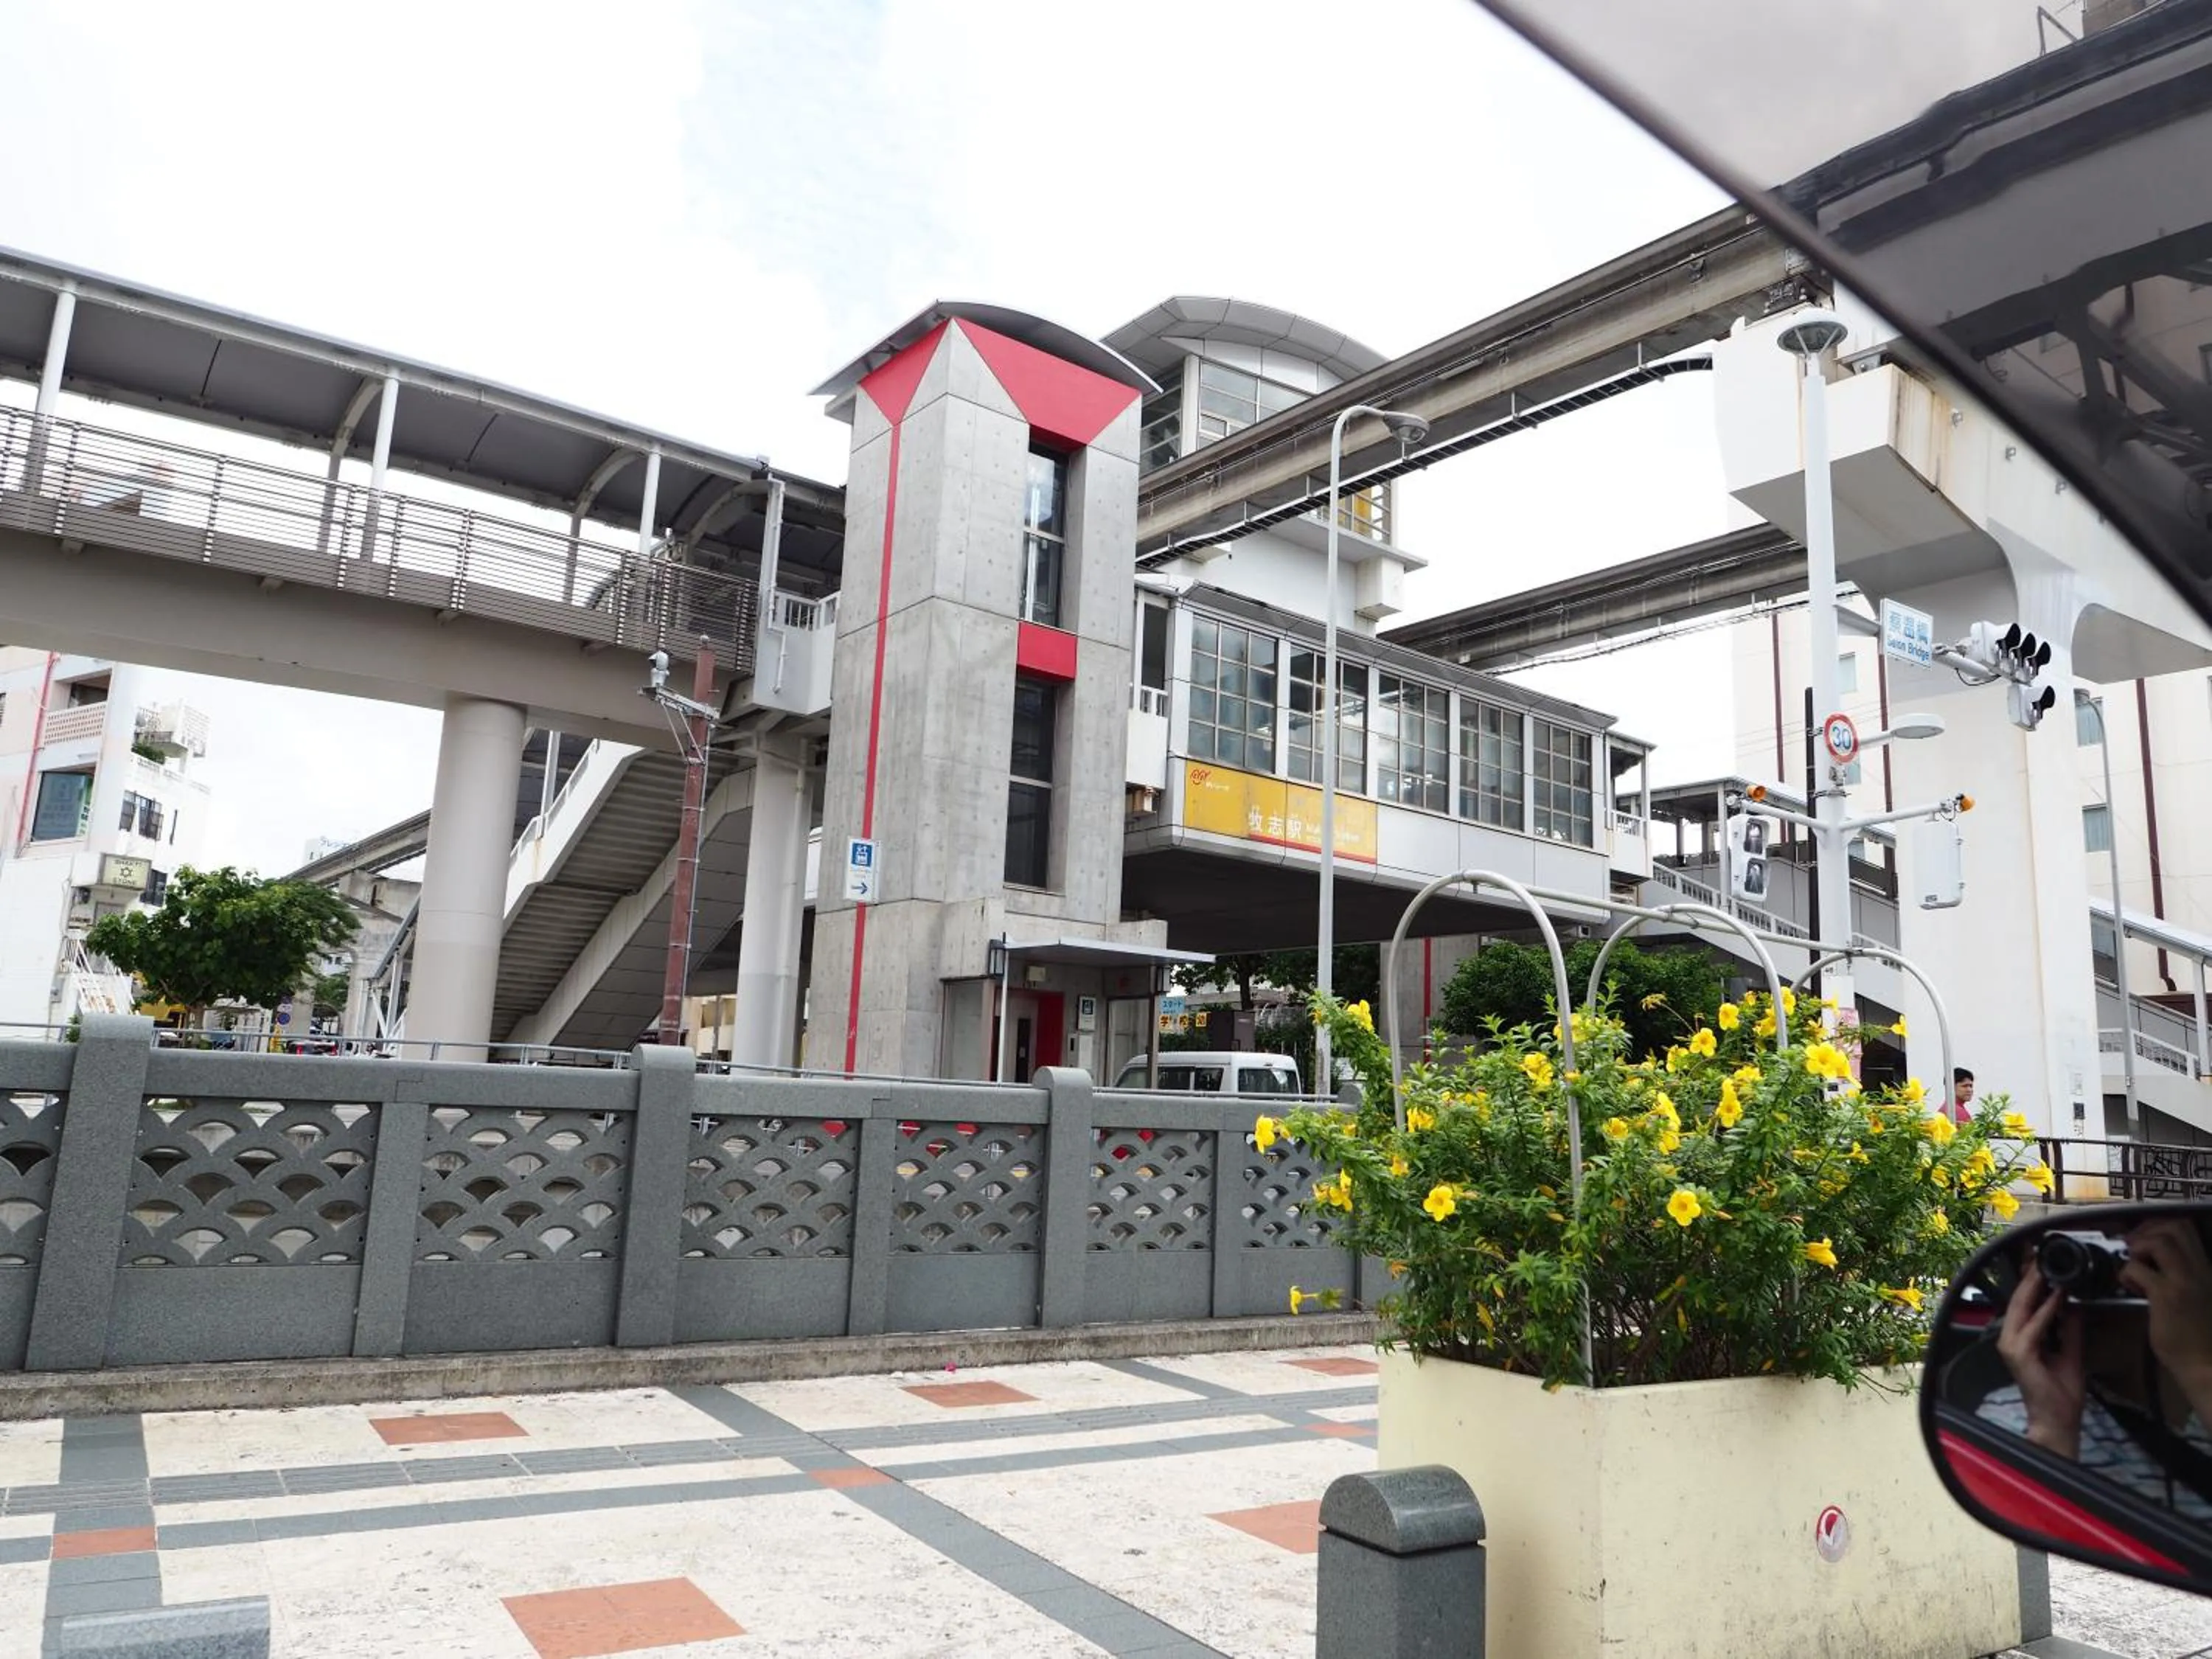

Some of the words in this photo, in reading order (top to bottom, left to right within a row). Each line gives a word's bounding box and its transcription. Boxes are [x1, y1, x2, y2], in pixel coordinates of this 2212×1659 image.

[1832, 726, 1851, 750] 30
[1248, 804, 1303, 841] 牧志駅
